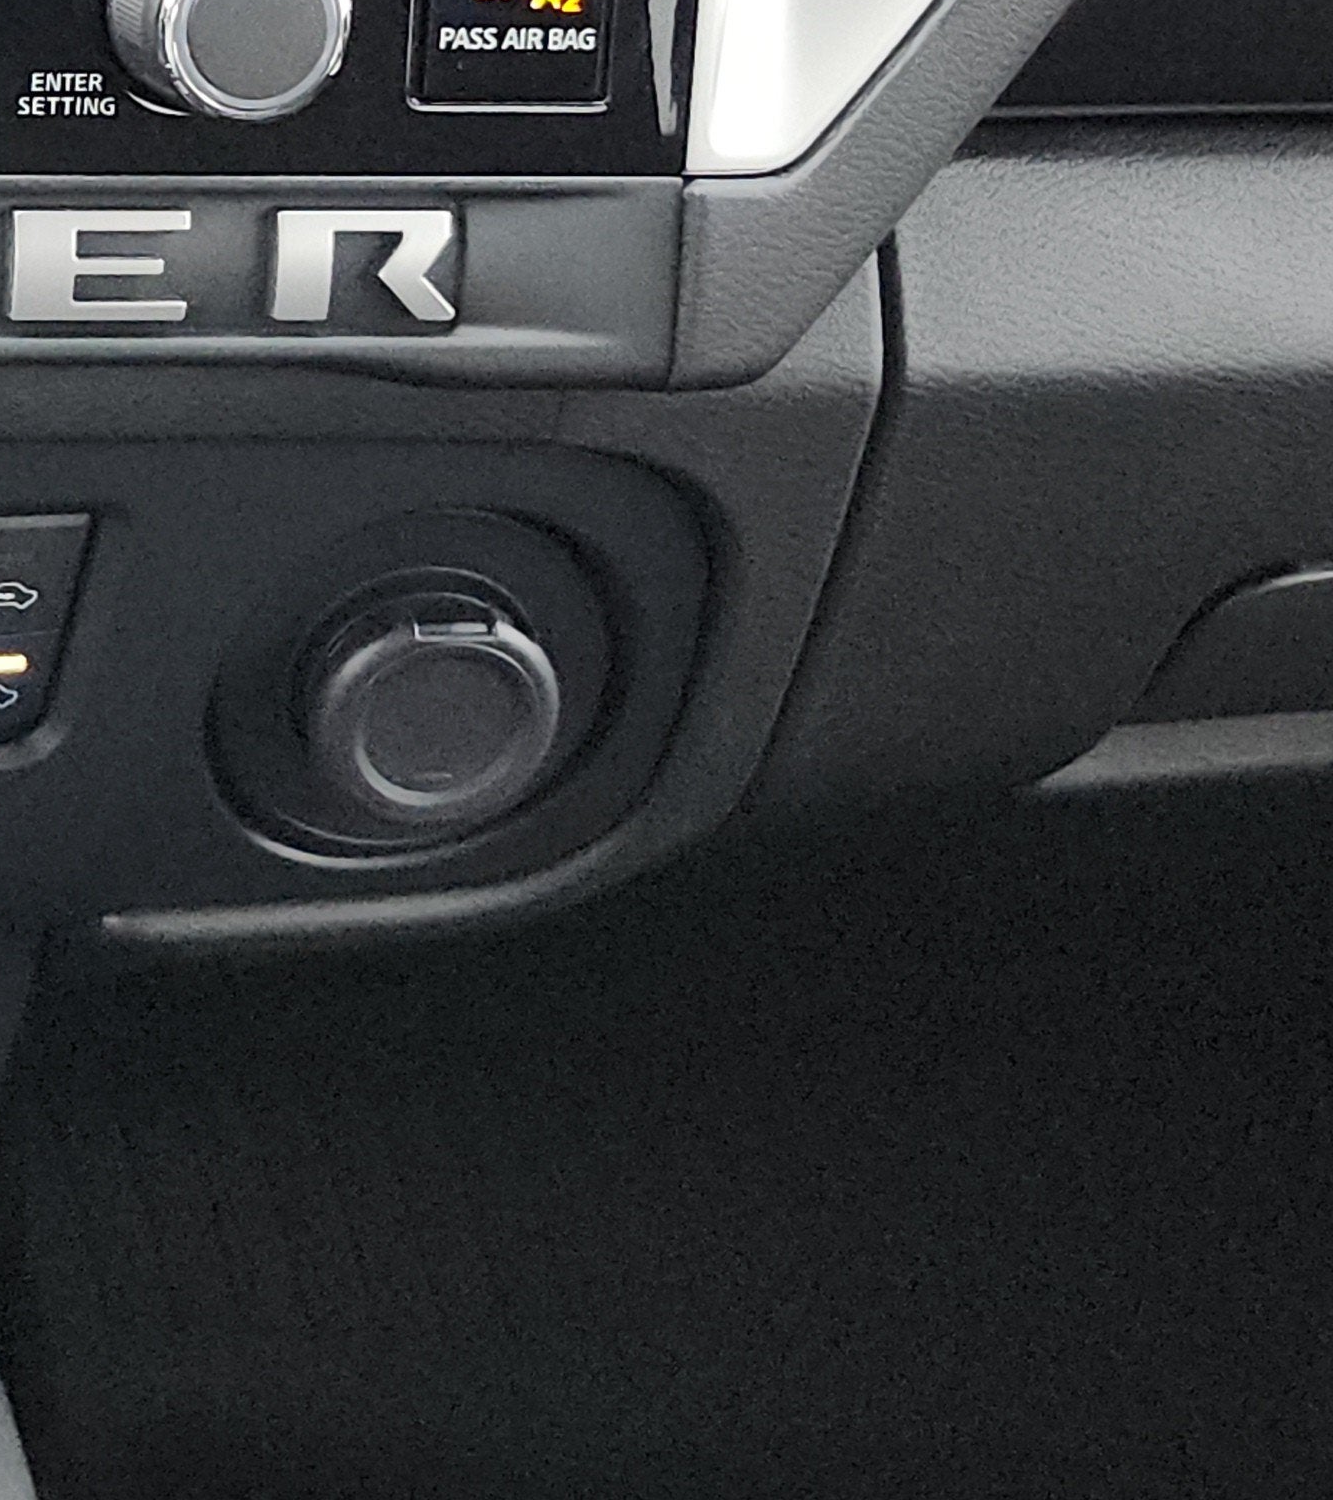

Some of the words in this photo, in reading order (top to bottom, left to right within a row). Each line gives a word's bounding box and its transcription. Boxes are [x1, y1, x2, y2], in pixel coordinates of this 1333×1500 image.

[440, 28, 499, 51] PASS
[502, 28, 545, 51] AIR
[548, 28, 597, 52] BAG
[31, 73, 104, 93] ENTER
[19, 97, 116, 117] SETTING
